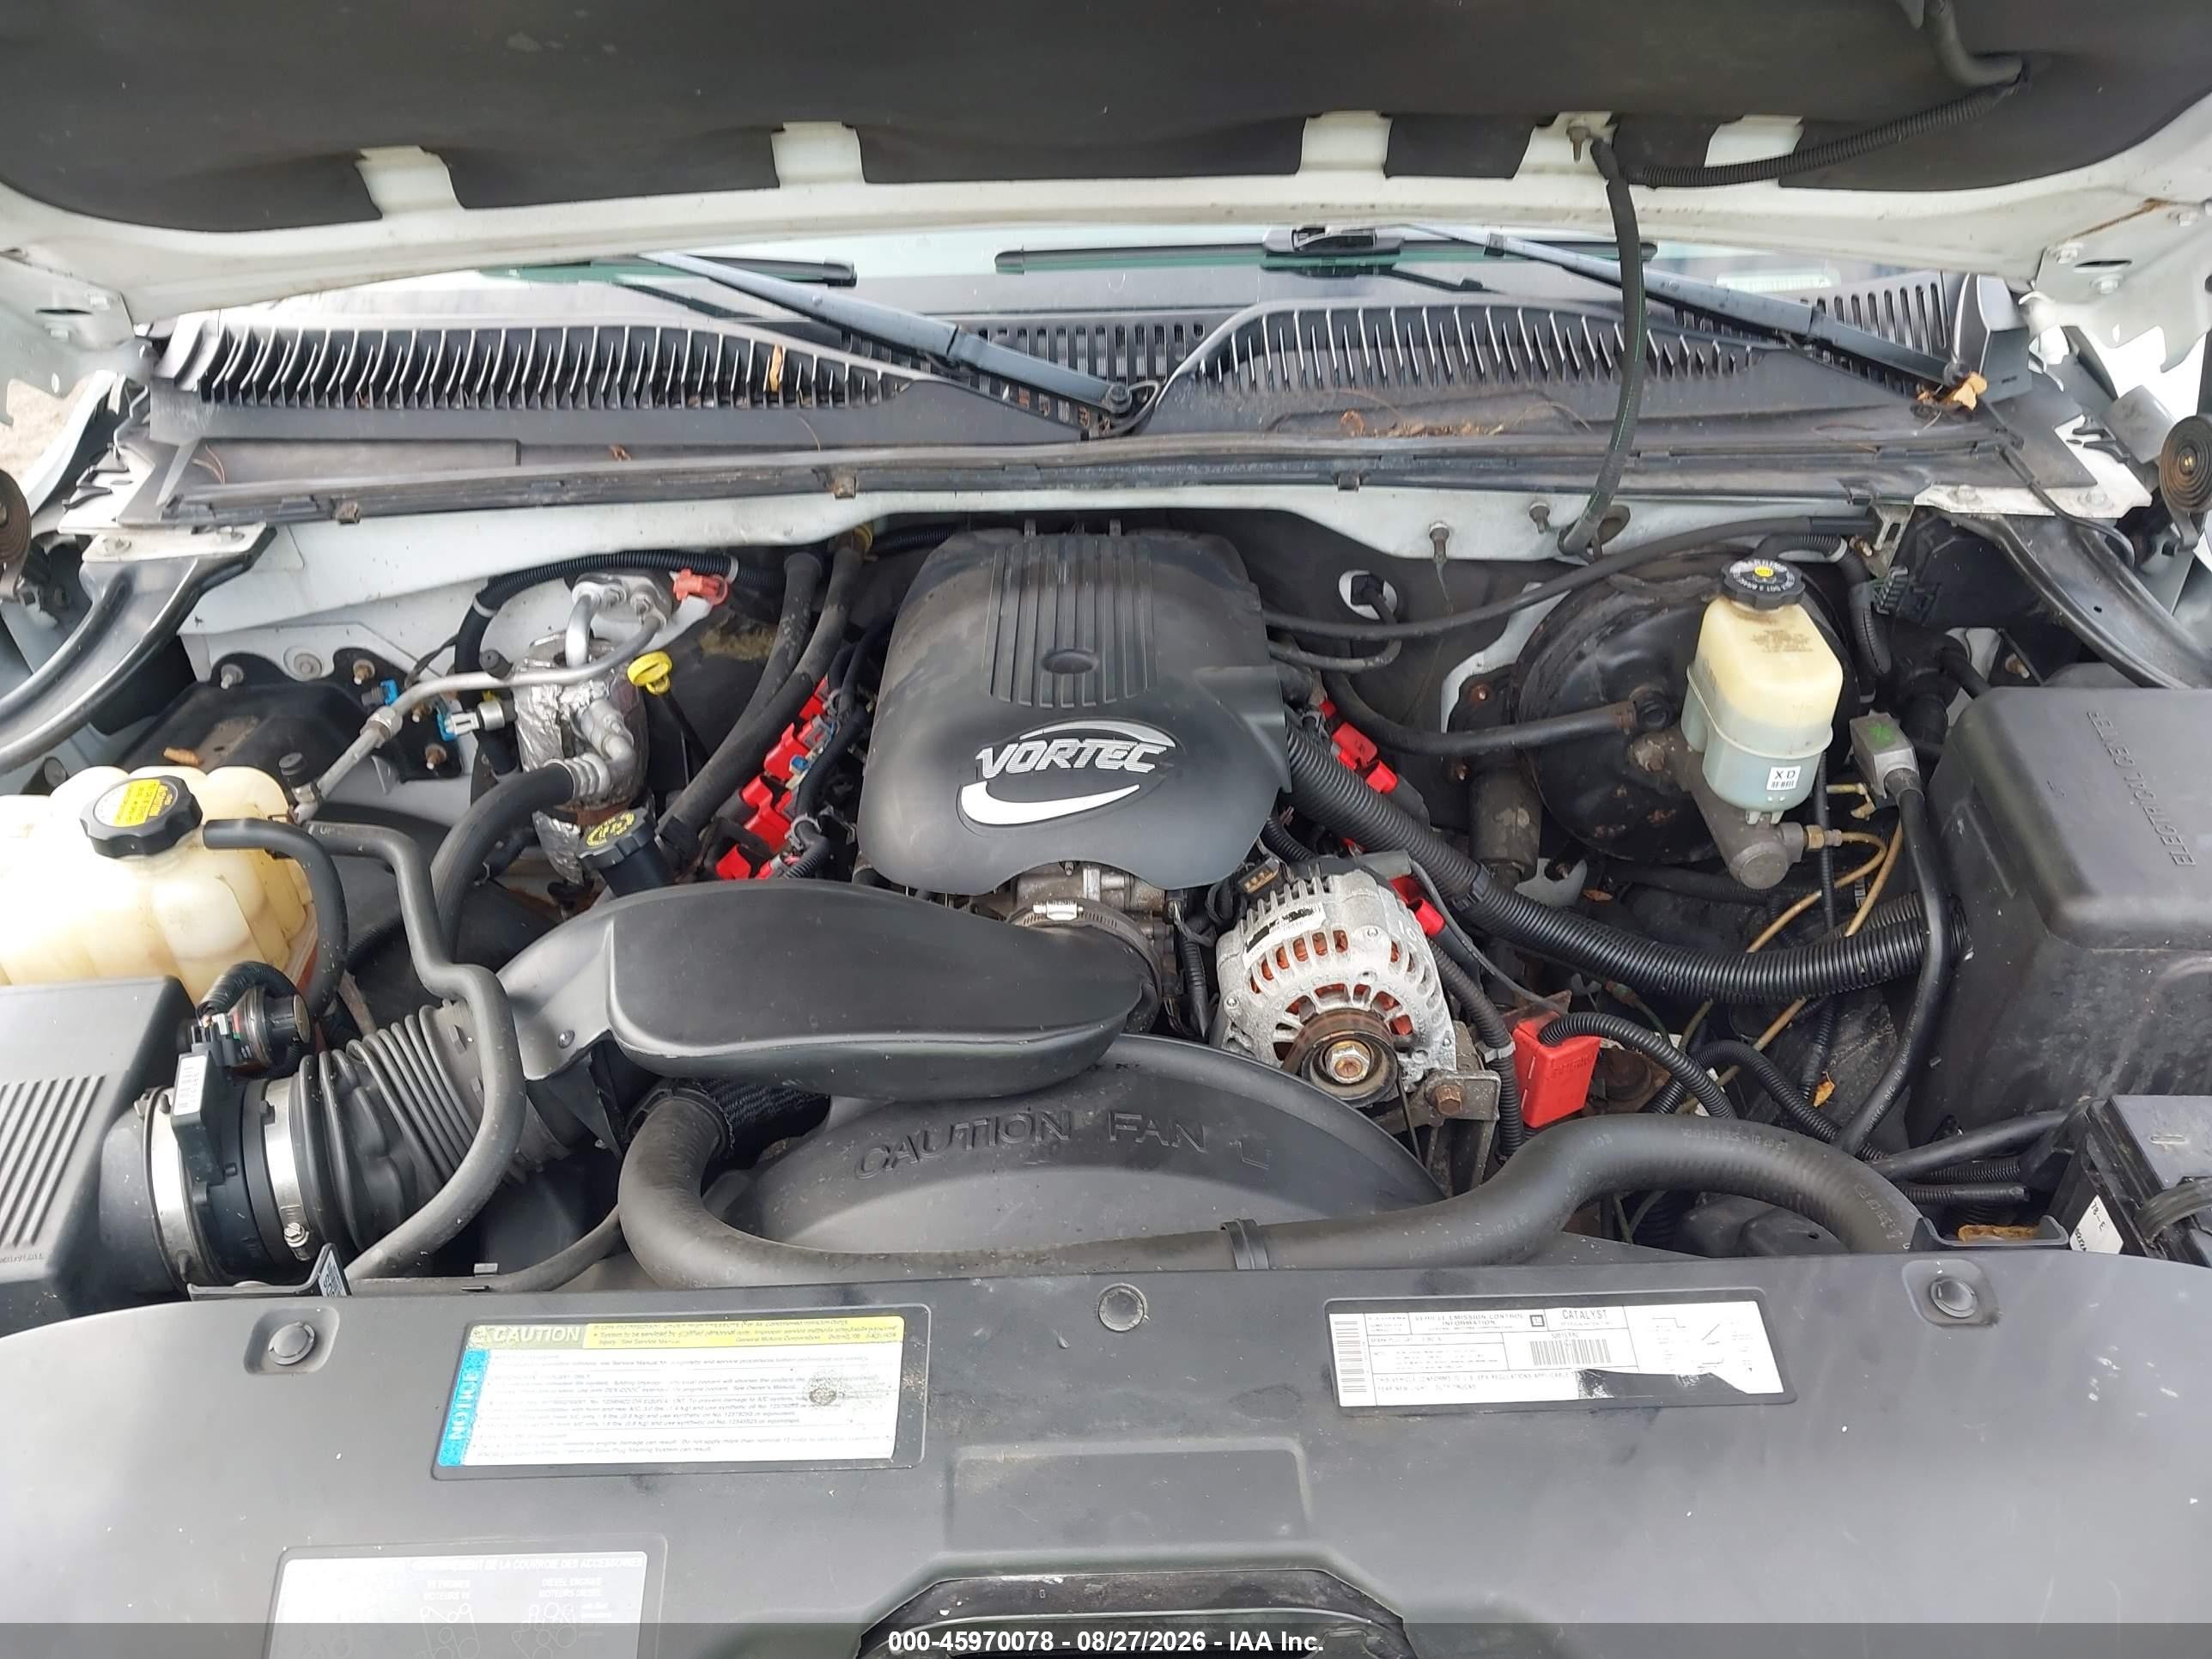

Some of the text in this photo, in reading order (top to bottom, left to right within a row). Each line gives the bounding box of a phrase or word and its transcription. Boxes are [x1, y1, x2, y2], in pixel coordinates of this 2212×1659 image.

[975, 738, 1169, 779] VORTEC
[854, 1110, 1072, 1180] CAUTION
[1107, 1111, 1207, 1153] FAN
[1561, 1309, 1607, 1322] CATALYST
[493, 1325, 580, 1343] CAUTION
[450, 1367, 483, 1441] NOTICE
[501, 1559, 513, 1570] LA
